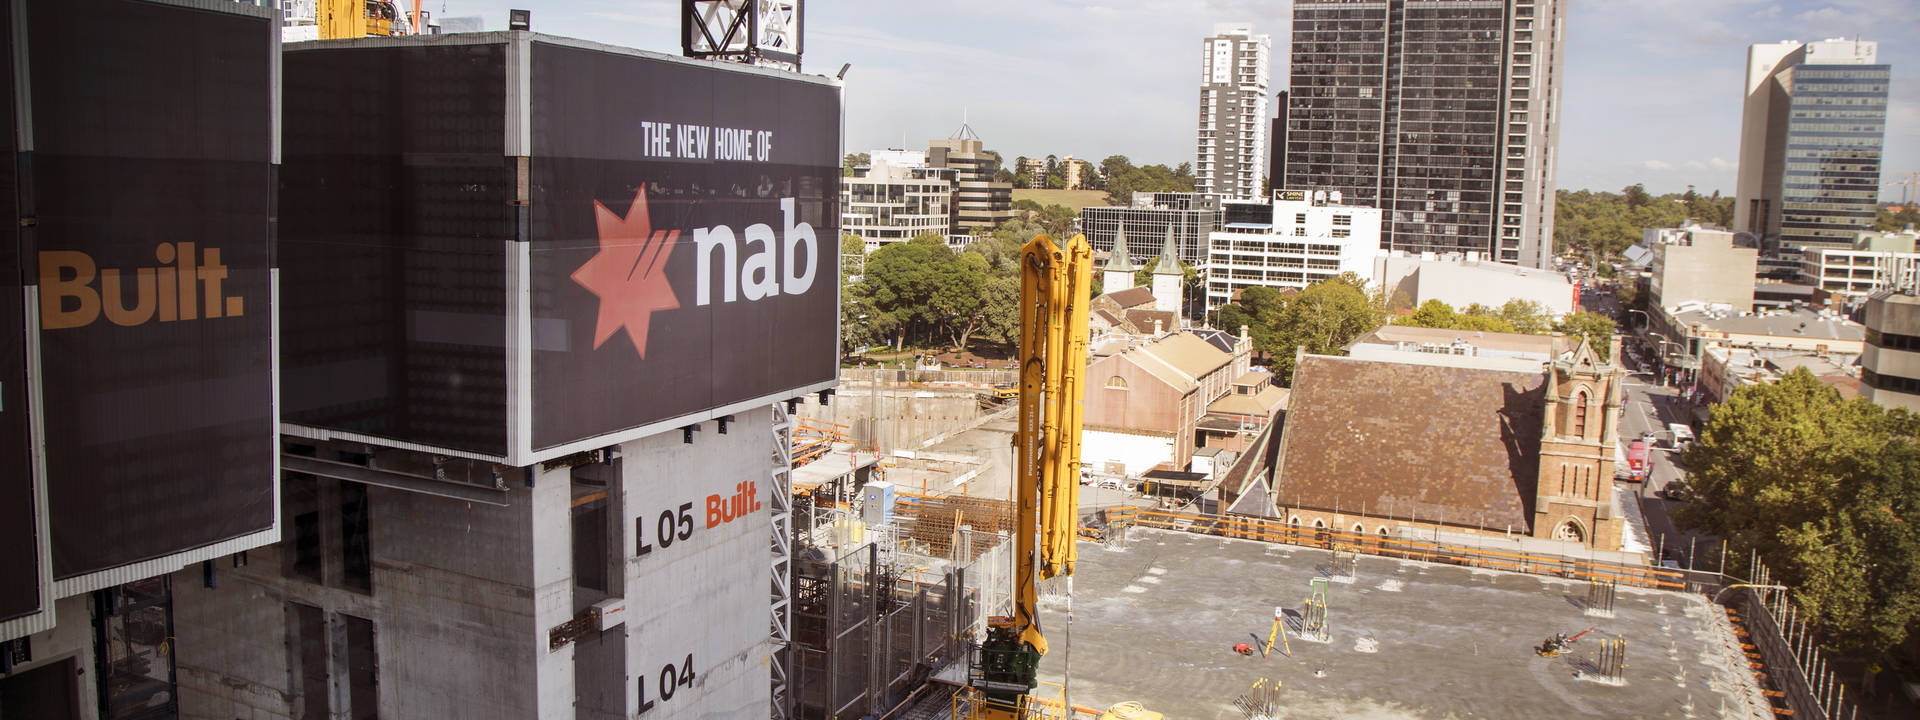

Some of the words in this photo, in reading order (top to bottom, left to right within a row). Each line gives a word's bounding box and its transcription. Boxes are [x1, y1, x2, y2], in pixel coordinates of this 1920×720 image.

[641, 121, 671, 157] THE
[676, 124, 709, 159] NEW
[714, 127, 753, 161] HOME
[757, 130, 773, 162] OF
[38, 241, 244, 330] Built.
[693, 197, 818, 306] nab
[706, 480, 761, 530] Built.
